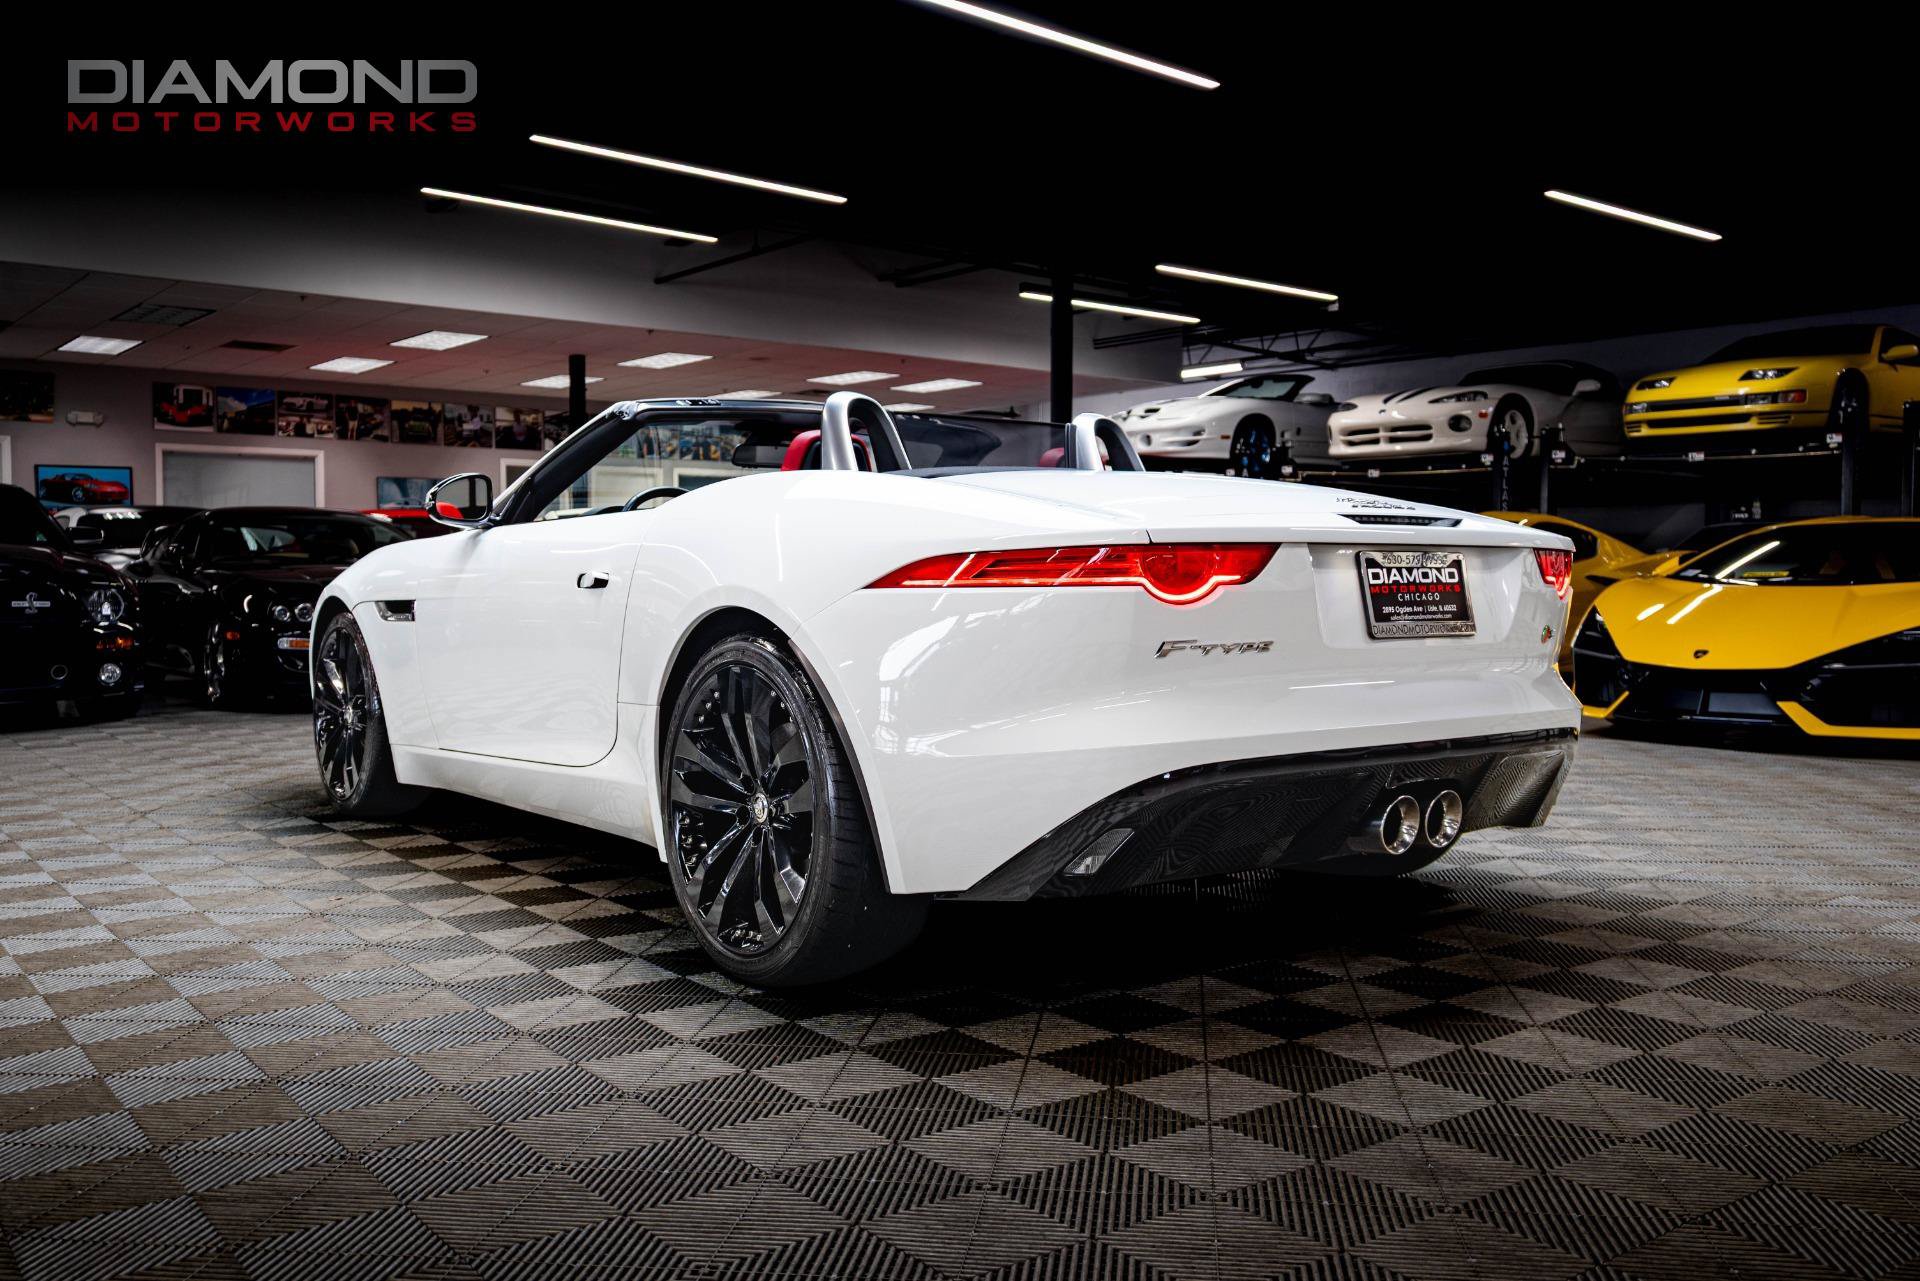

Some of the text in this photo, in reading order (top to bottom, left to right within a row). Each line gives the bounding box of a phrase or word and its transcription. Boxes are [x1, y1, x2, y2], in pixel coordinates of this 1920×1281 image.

[1367, 568, 1459, 584] DIAMOND
[1370, 584, 1461, 593] MOTORWORKS
[1397, 593, 1440, 601] CHICAGO
[1395, 605, 1413, 614] Ogden
[1413, 605, 1423, 613] Ave
[1154, 640, 1274, 658] F-TYPE
